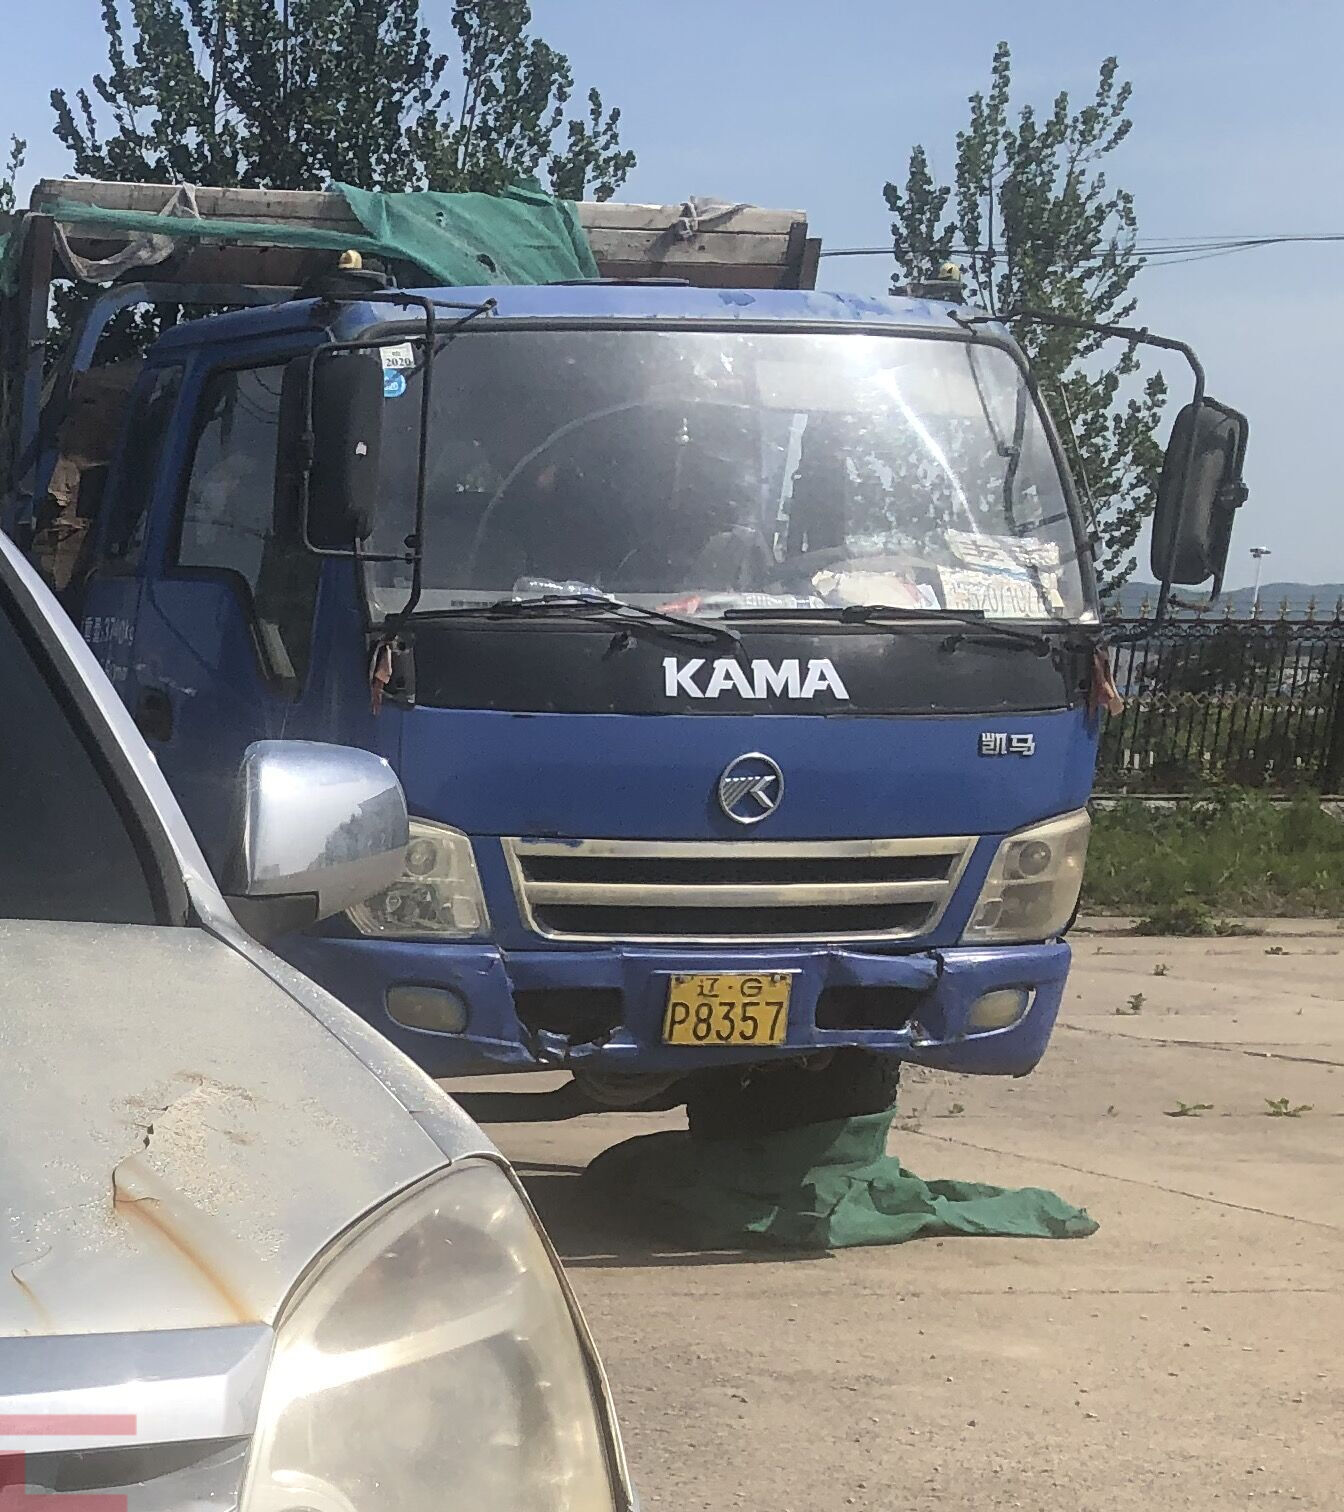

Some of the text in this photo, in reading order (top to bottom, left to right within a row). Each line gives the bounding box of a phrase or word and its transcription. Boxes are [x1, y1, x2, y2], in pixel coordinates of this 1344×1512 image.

[386, 357, 412, 367] 2020
[662, 657, 850, 699] KAMA
[981, 732, 1035, 755] 凯马
[668, 1001, 784, 1041] P8357
